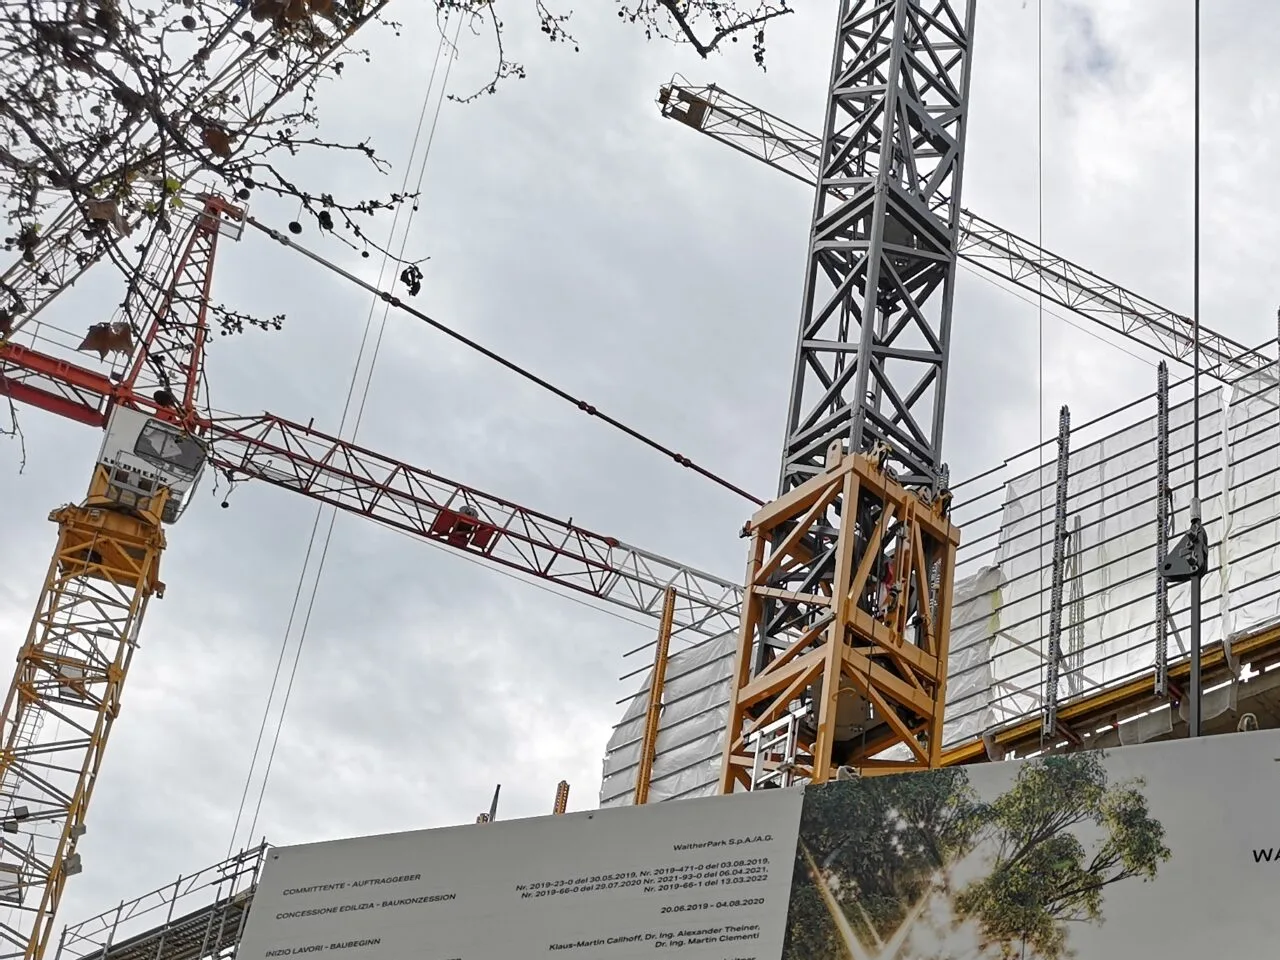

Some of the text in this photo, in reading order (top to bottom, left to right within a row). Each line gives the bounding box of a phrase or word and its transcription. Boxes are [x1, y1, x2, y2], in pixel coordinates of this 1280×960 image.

[275, 906, 339, 920] CONCESSIONE
[677, 927, 723, 937] Alexander
[329, 938, 381, 950] BAUBEGINN
